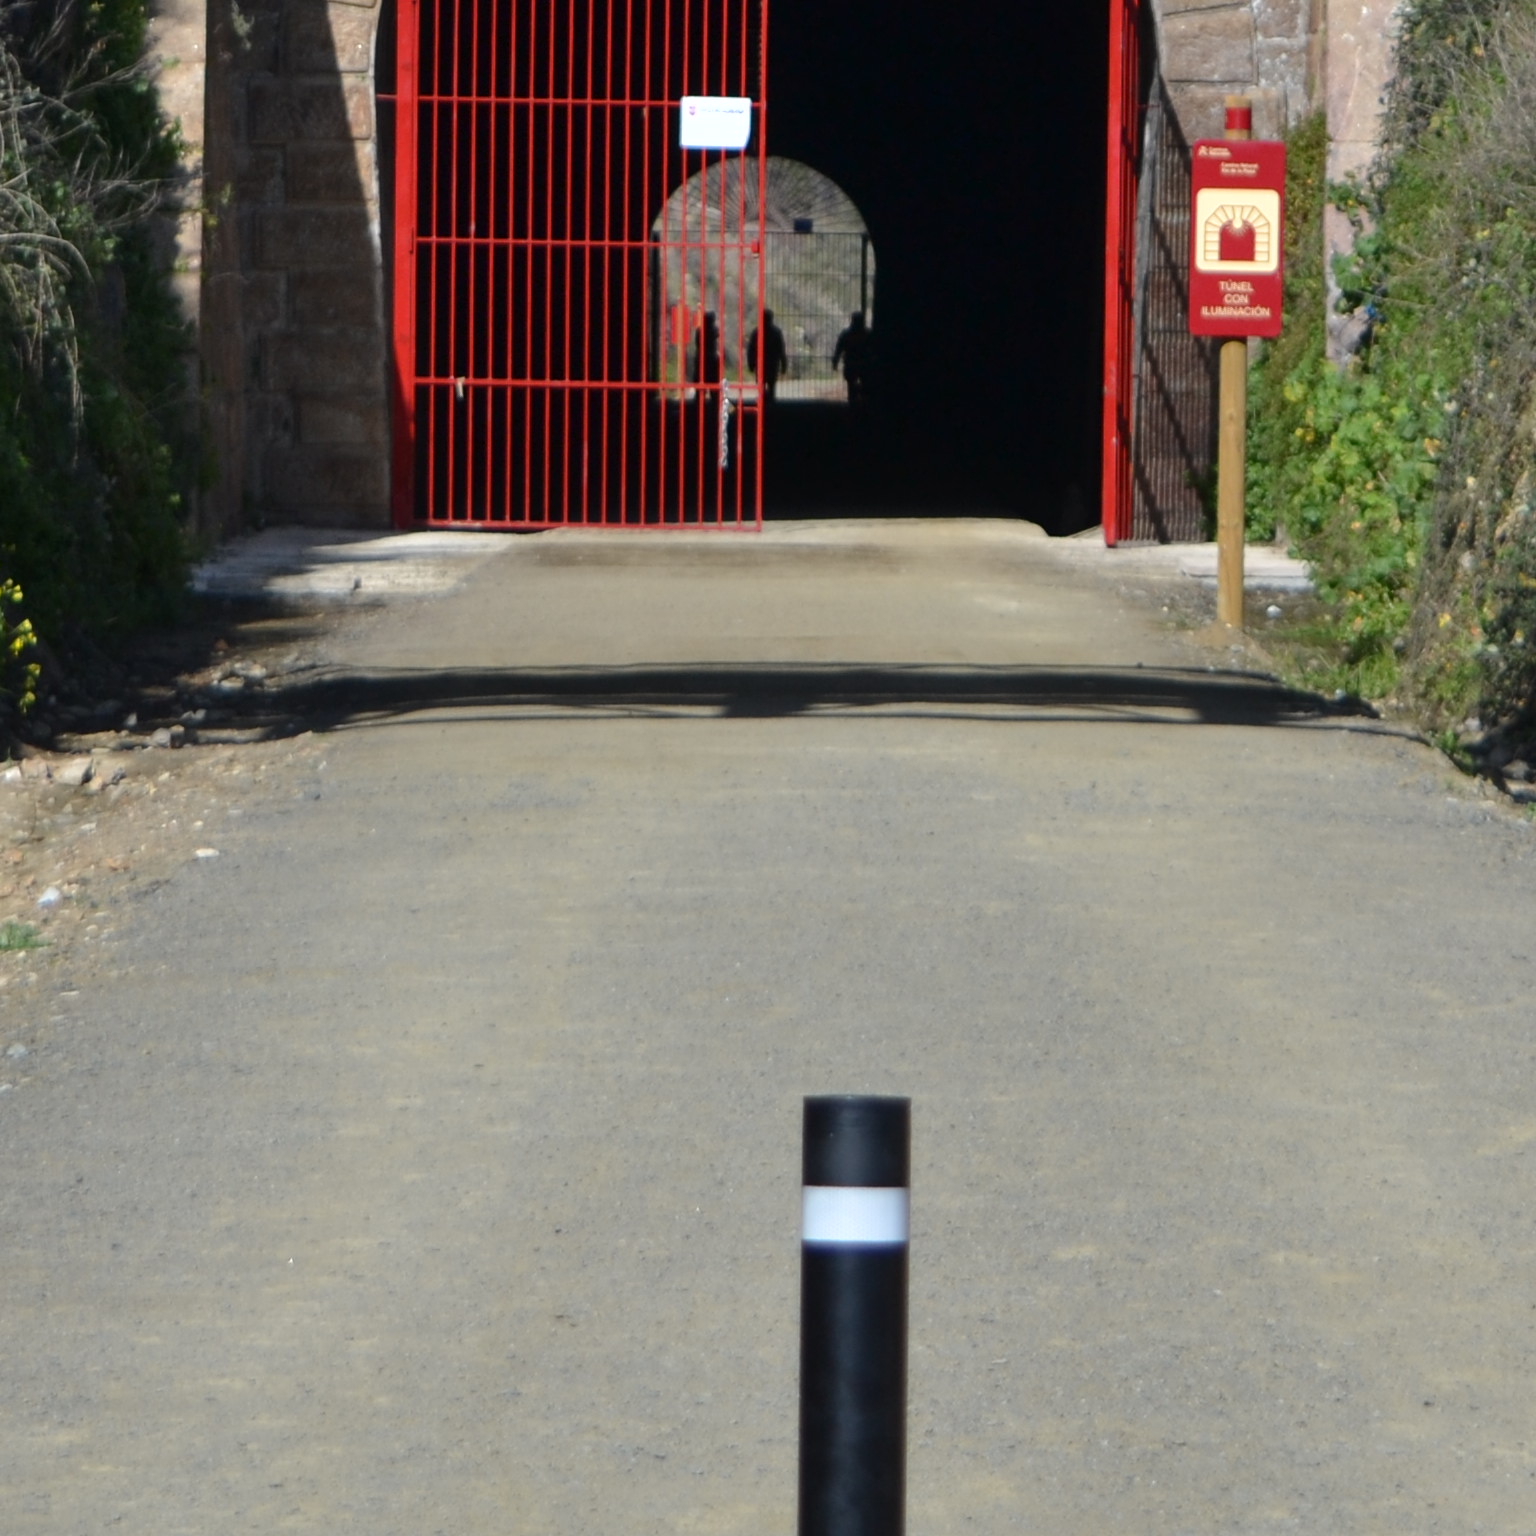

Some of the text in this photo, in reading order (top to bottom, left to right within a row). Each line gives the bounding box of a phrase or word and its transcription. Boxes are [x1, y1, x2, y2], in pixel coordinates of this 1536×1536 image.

[1218, 278, 1255, 292] TÚNEL
[1224, 293, 1249, 304] CON
[1201, 304, 1271, 317] ILUMINACIÓN
